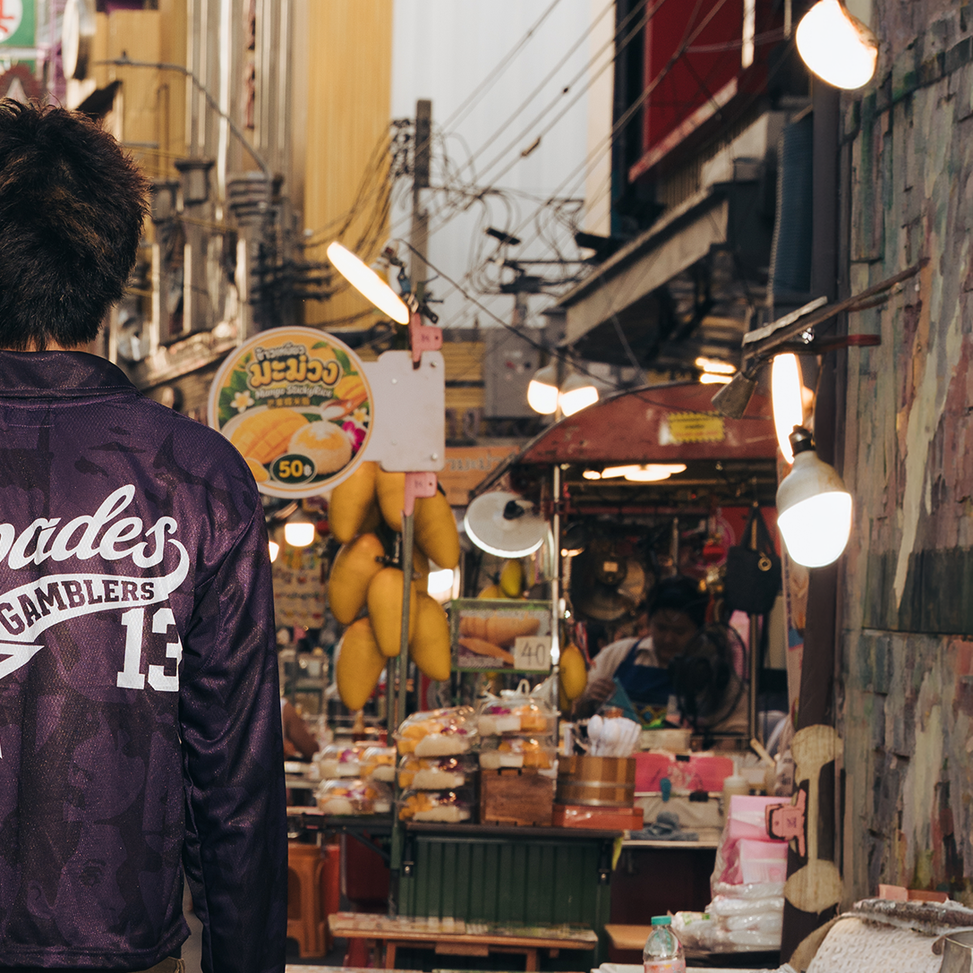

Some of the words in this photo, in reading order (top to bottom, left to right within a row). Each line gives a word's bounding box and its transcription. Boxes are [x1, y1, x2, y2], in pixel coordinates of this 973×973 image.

[249, 354, 339, 388] มะม่วง
[116, 607, 183, 692] 13
[521, 641, 545, 667] 40
